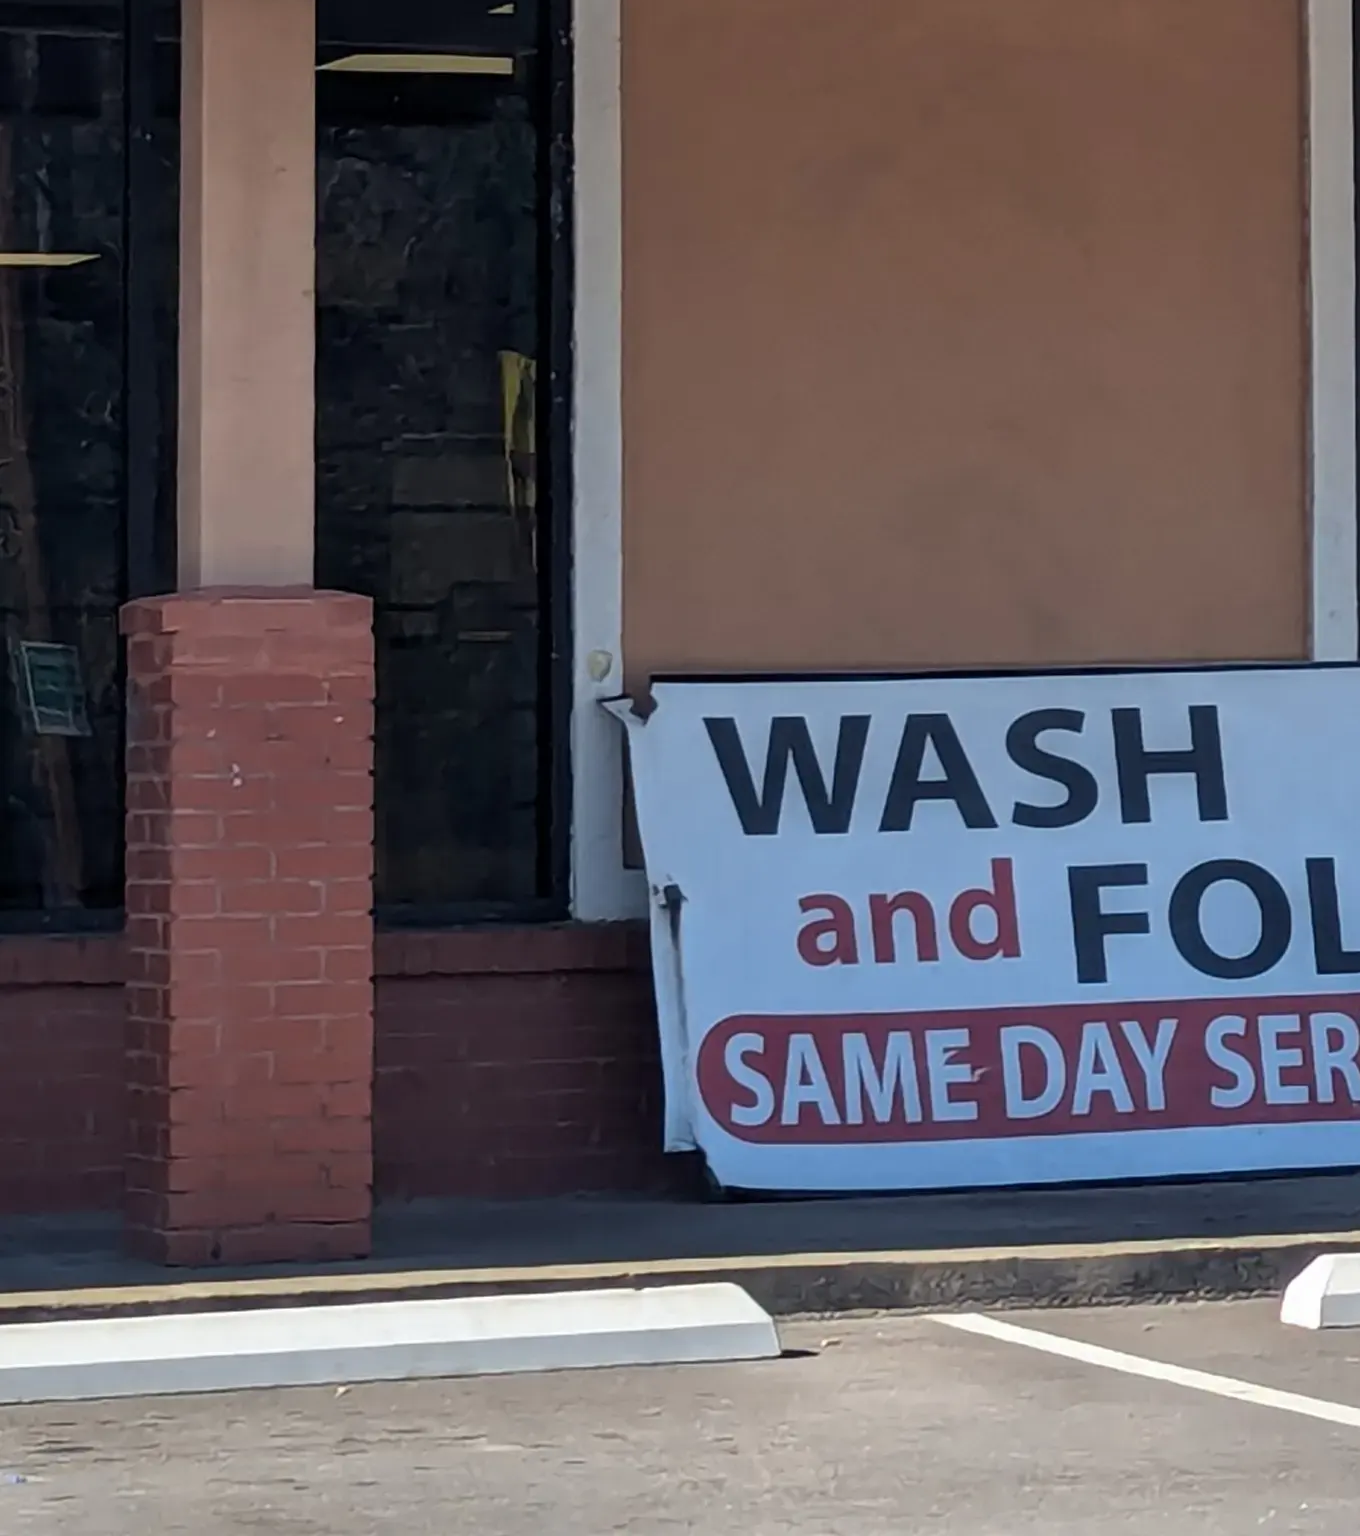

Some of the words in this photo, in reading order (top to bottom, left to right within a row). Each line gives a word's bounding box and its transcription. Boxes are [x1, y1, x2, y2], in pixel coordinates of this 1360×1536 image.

[702, 704, 1230, 836] WASH
[796, 857, 1021, 967] and
[723, 1026, 980, 1128] SAME
[1000, 1017, 1182, 1120] DAY
